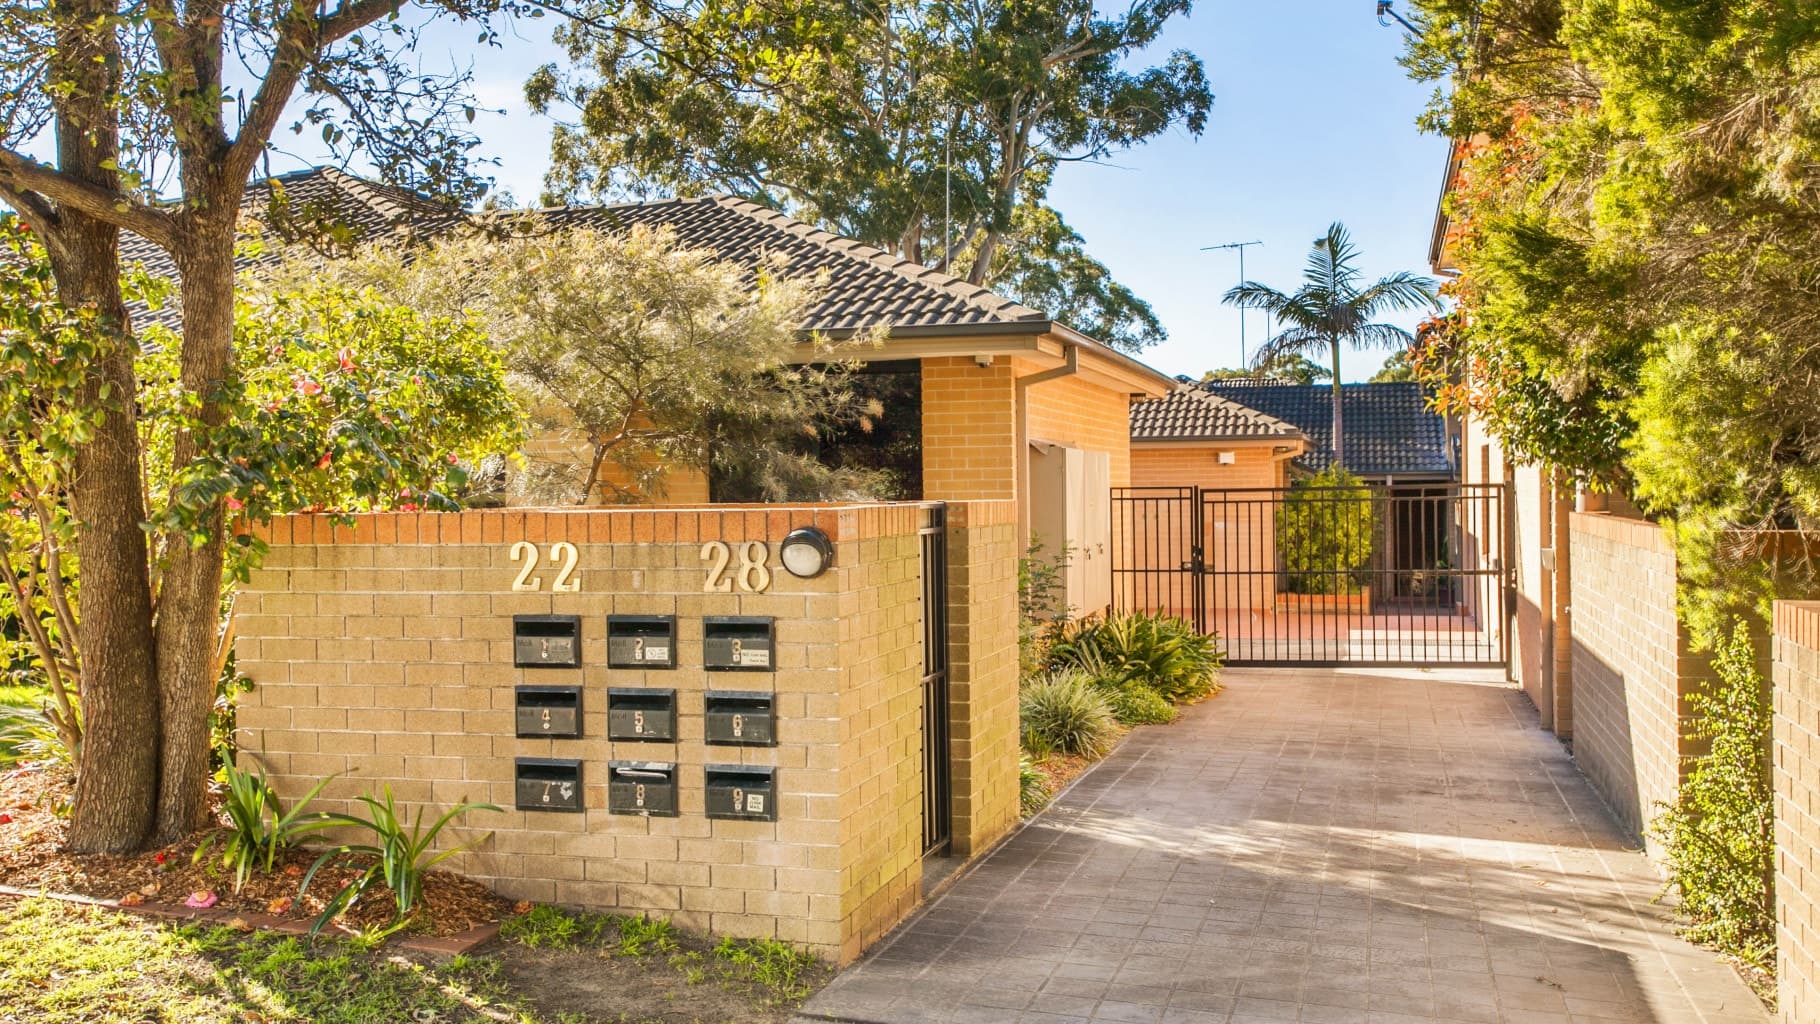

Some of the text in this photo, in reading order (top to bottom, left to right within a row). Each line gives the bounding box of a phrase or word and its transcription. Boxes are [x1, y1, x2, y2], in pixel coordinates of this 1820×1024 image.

[510, 541, 581, 592] 22
[700, 540, 770, 593] 28
[541, 708, 551, 721] 4
[634, 711, 644, 726] 5
[732, 714, 743, 730] 6
[636, 784, 645, 800] 8
[733, 788, 744, 804] 9
